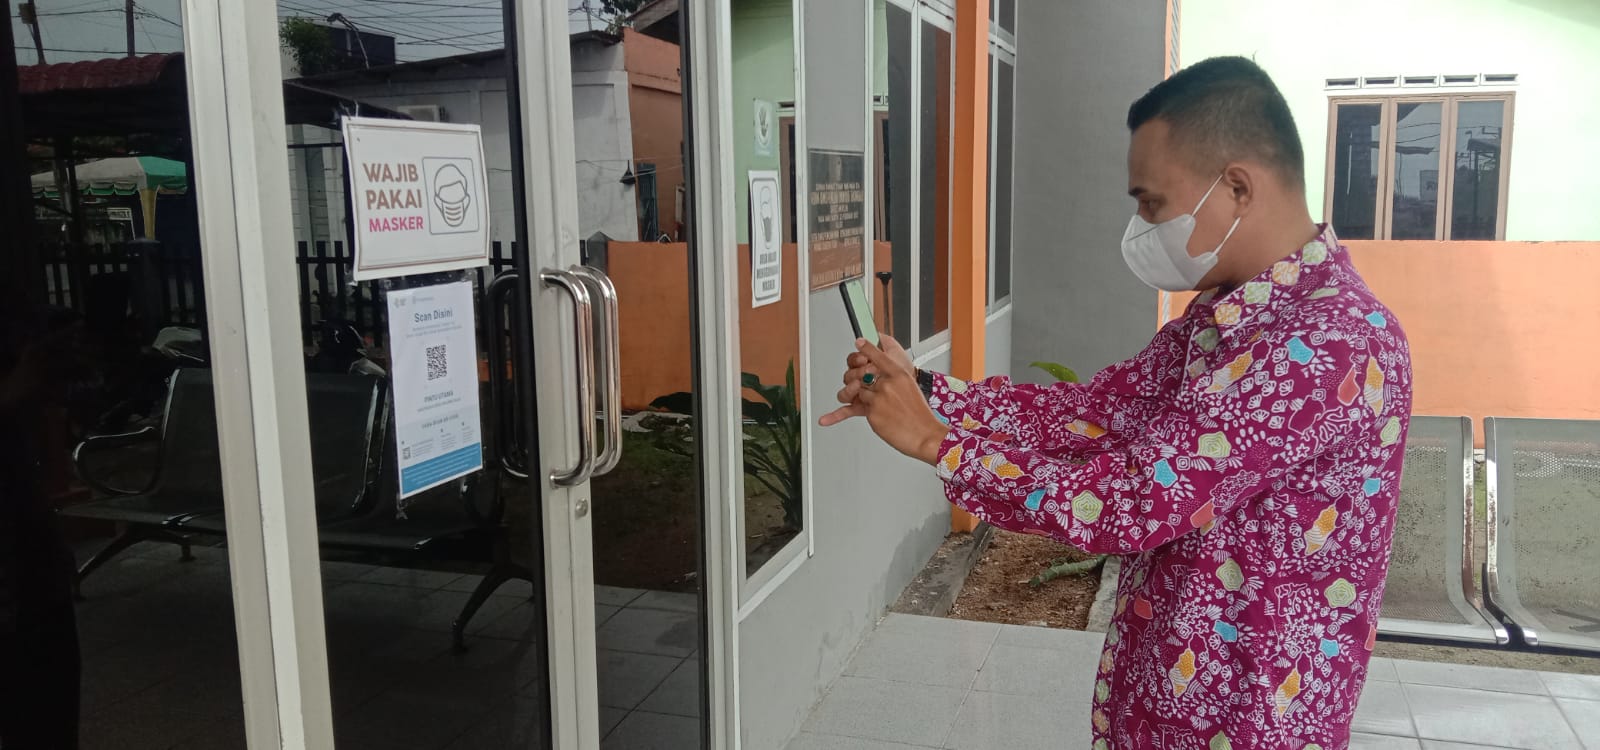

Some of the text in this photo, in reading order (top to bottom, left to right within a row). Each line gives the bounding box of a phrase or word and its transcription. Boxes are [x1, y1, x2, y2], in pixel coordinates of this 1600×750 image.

[363, 163, 419, 182] WAJIB
[366, 189, 423, 210] PAKAI
[369, 216, 424, 232] MASKER
[414, 307, 453, 323] Scan Disini
